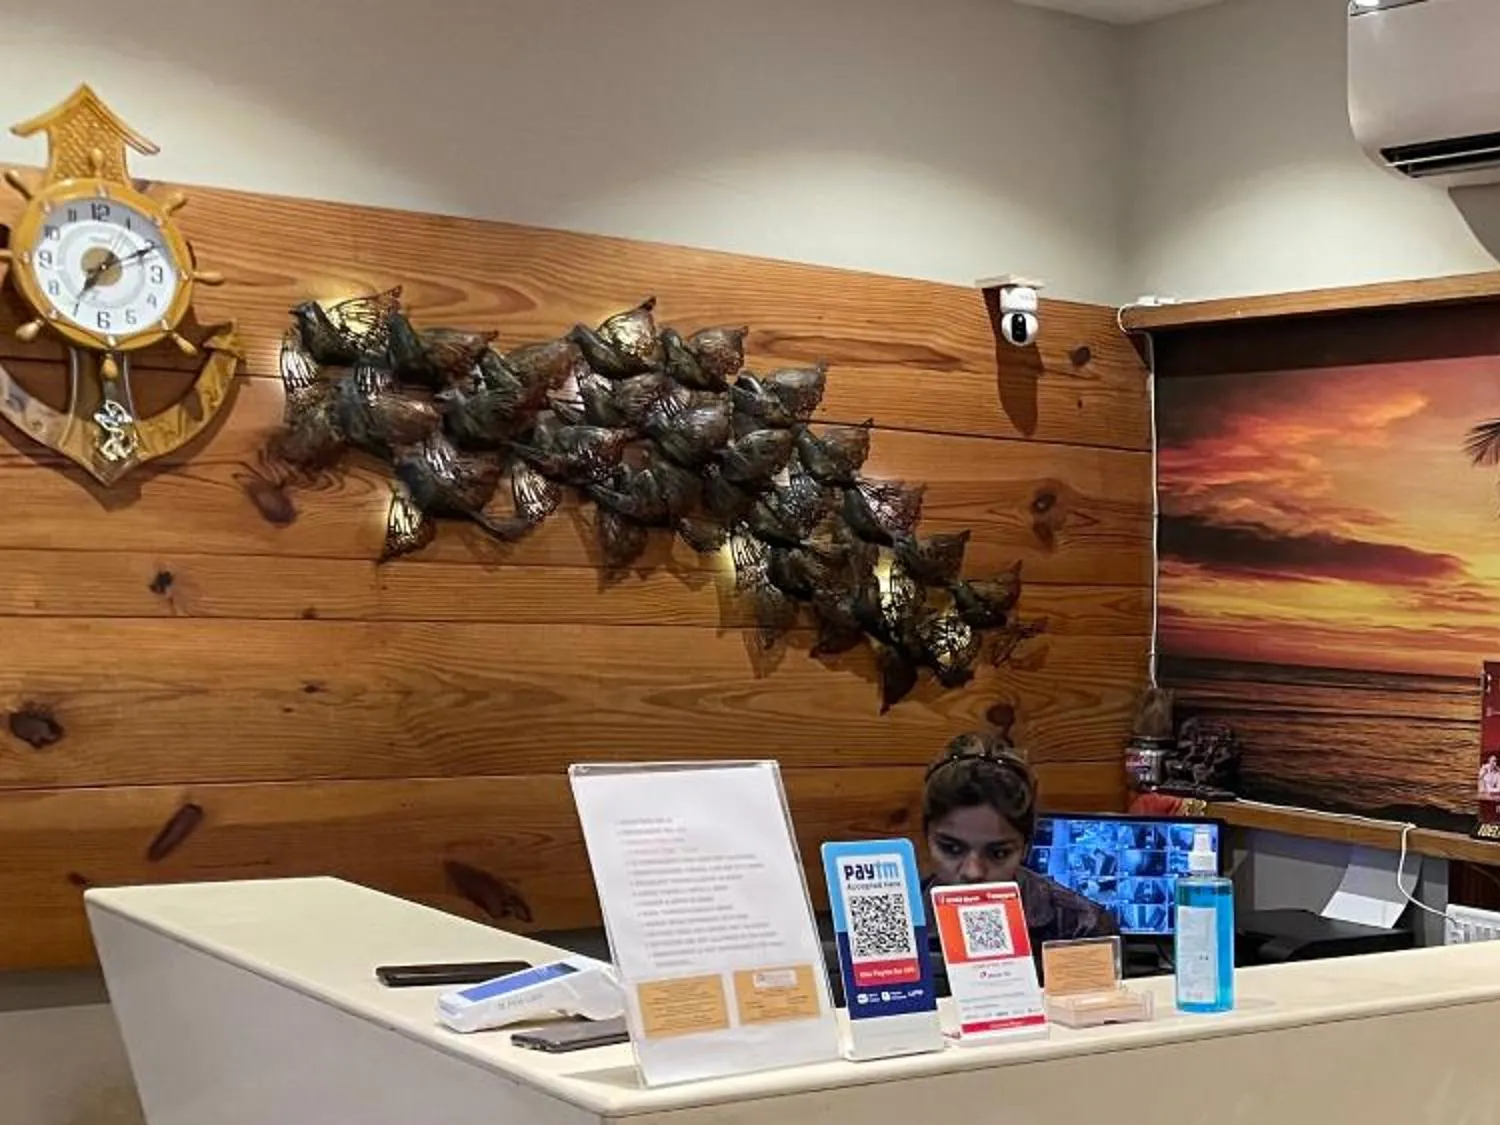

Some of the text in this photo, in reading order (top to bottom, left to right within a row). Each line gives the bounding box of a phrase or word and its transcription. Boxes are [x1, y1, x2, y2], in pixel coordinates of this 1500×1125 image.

[91, 203, 110, 222] 12
[39, 249, 53, 269] 9
[151, 265, 163, 285] 3
[96, 311, 111, 329] 6
[125, 308, 137, 325] 5
